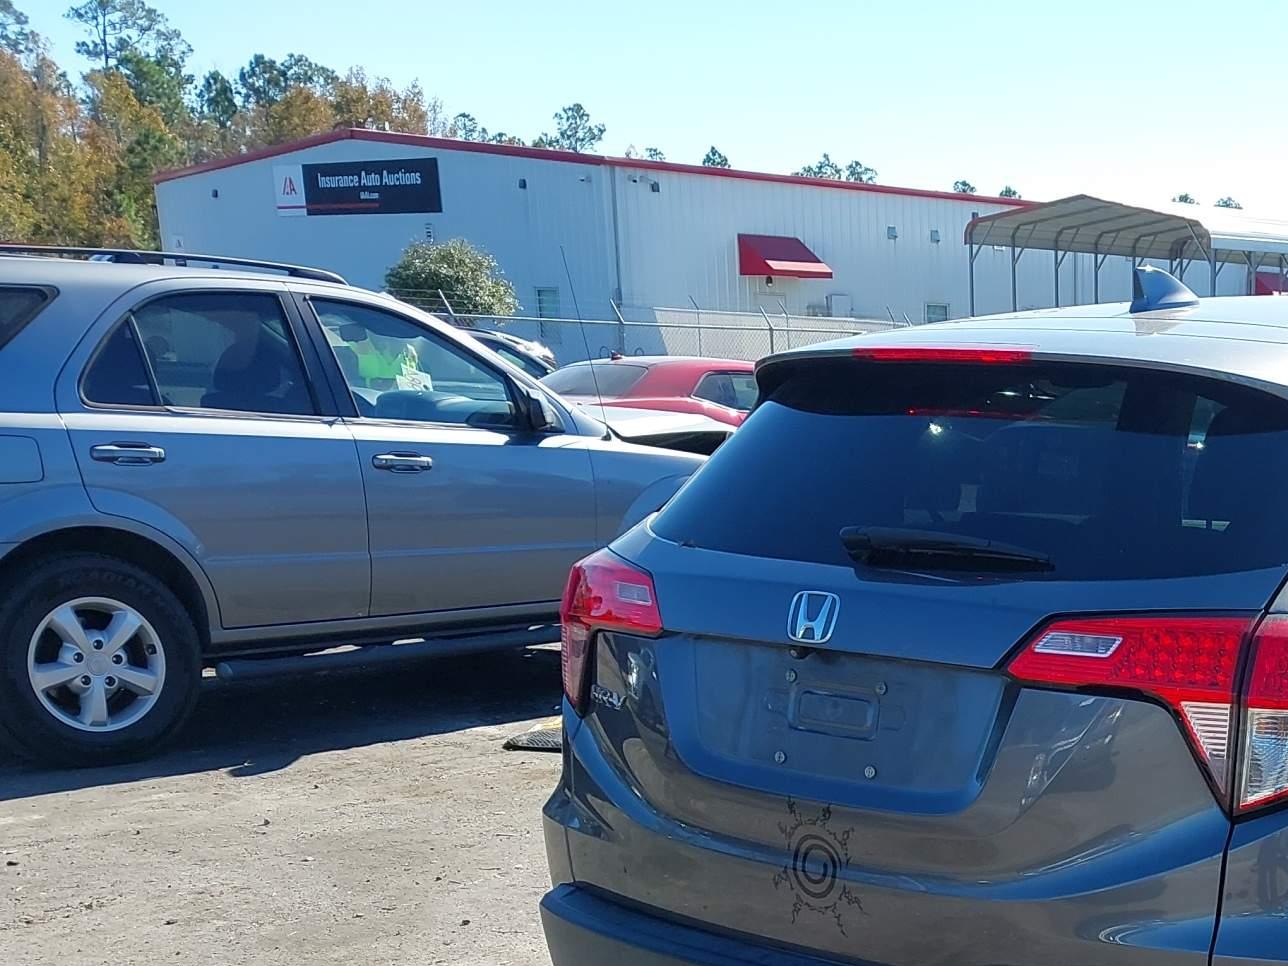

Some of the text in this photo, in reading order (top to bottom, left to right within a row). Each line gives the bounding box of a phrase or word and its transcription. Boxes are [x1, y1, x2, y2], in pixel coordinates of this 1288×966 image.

[317, 169, 422, 189] Insurance Auto Auctions
